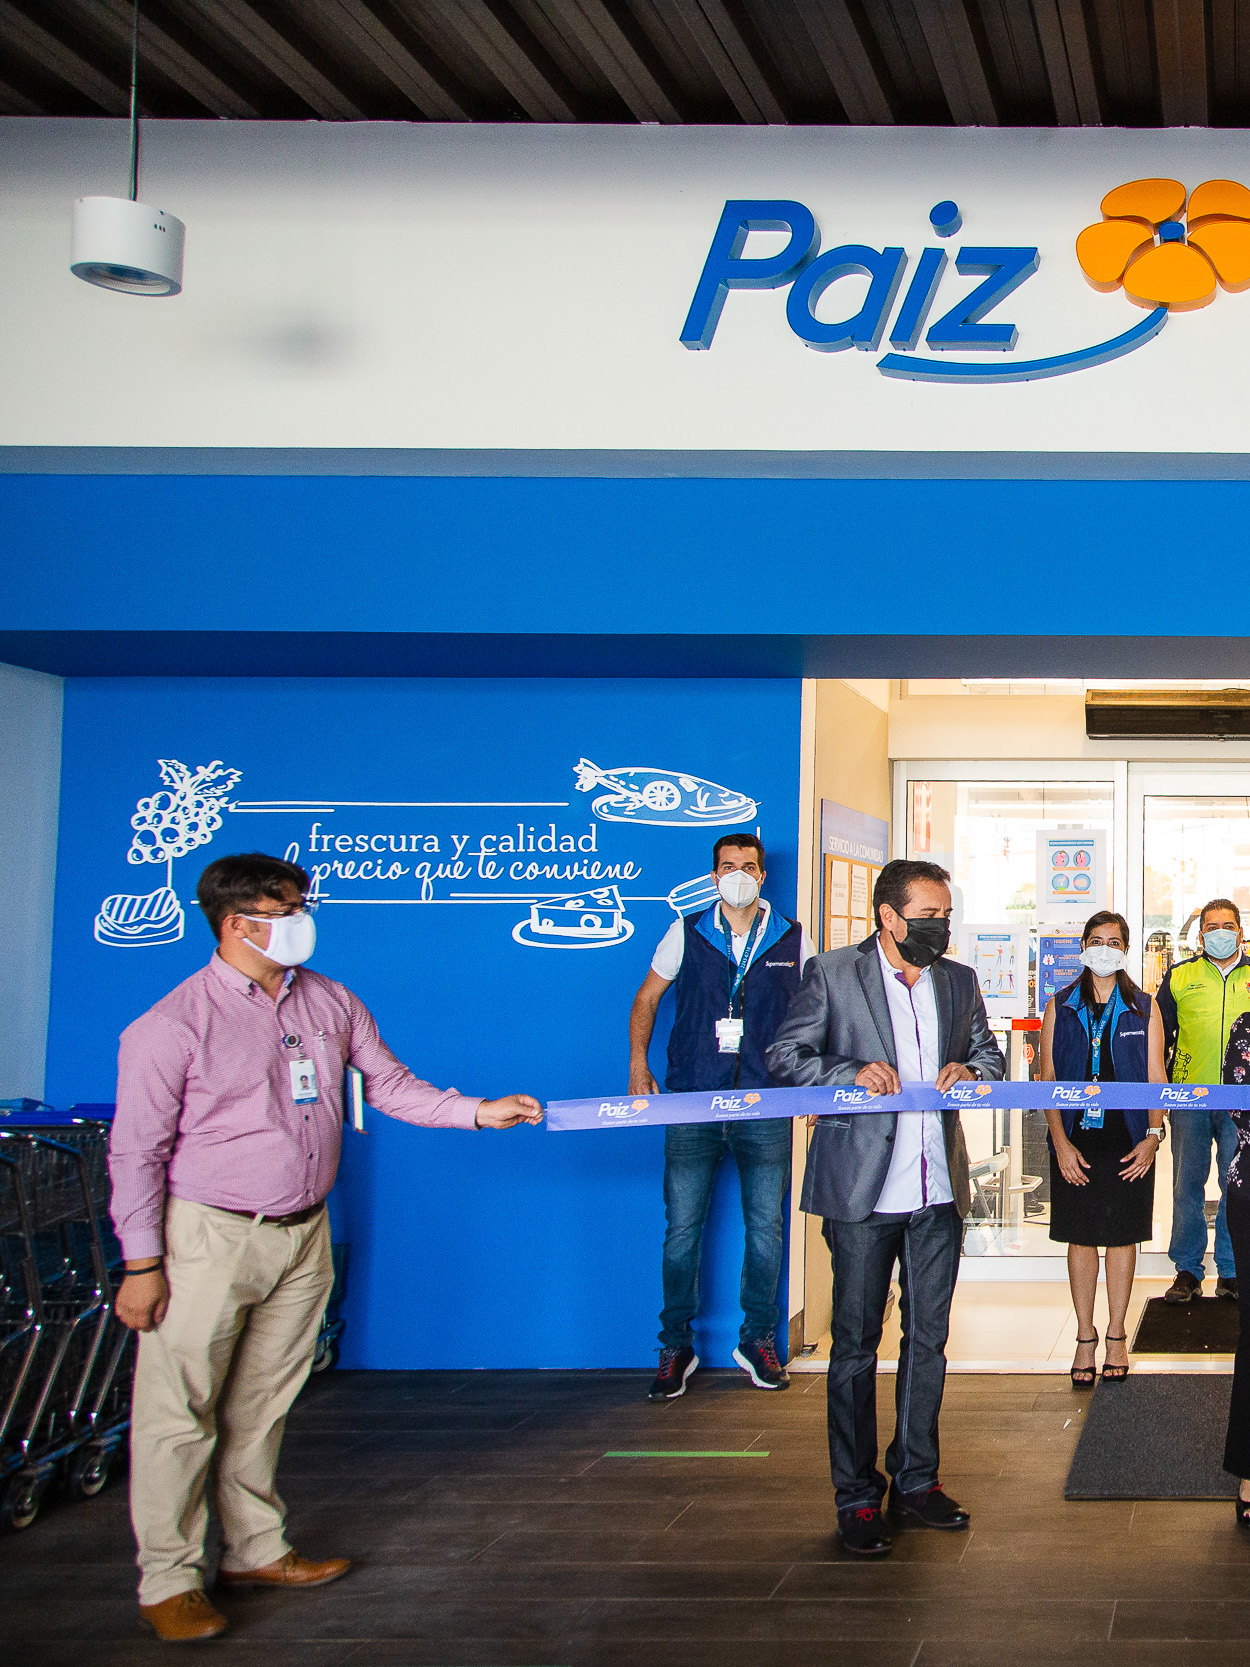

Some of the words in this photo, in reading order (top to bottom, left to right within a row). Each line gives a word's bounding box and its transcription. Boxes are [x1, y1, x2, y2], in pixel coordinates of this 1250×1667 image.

[680, 200, 1040, 352] Paiz
[308, 822, 441, 853] frescura
[450, 834, 470, 861] y
[479, 823, 598, 853] calidad
[829, 836, 849, 854] SERVICIO
[853, 844, 860, 857] LA
[860, 844, 884, 863] COMUNIDAD
[306, 858, 410, 901] precio
[415, 860, 472, 900] que
[468, 851, 505, 880] te
[509, 859, 643, 881] conviene
[833, 1089, 864, 1103] Paiz
[942, 1086, 973, 1099] Paiz
[1051, 1086, 1083, 1099] Paiz
[1160, 1087, 1191, 1100] Paiz
[598, 1102, 629, 1117] Paiz
[710, 1095, 742, 1110] Paiz
